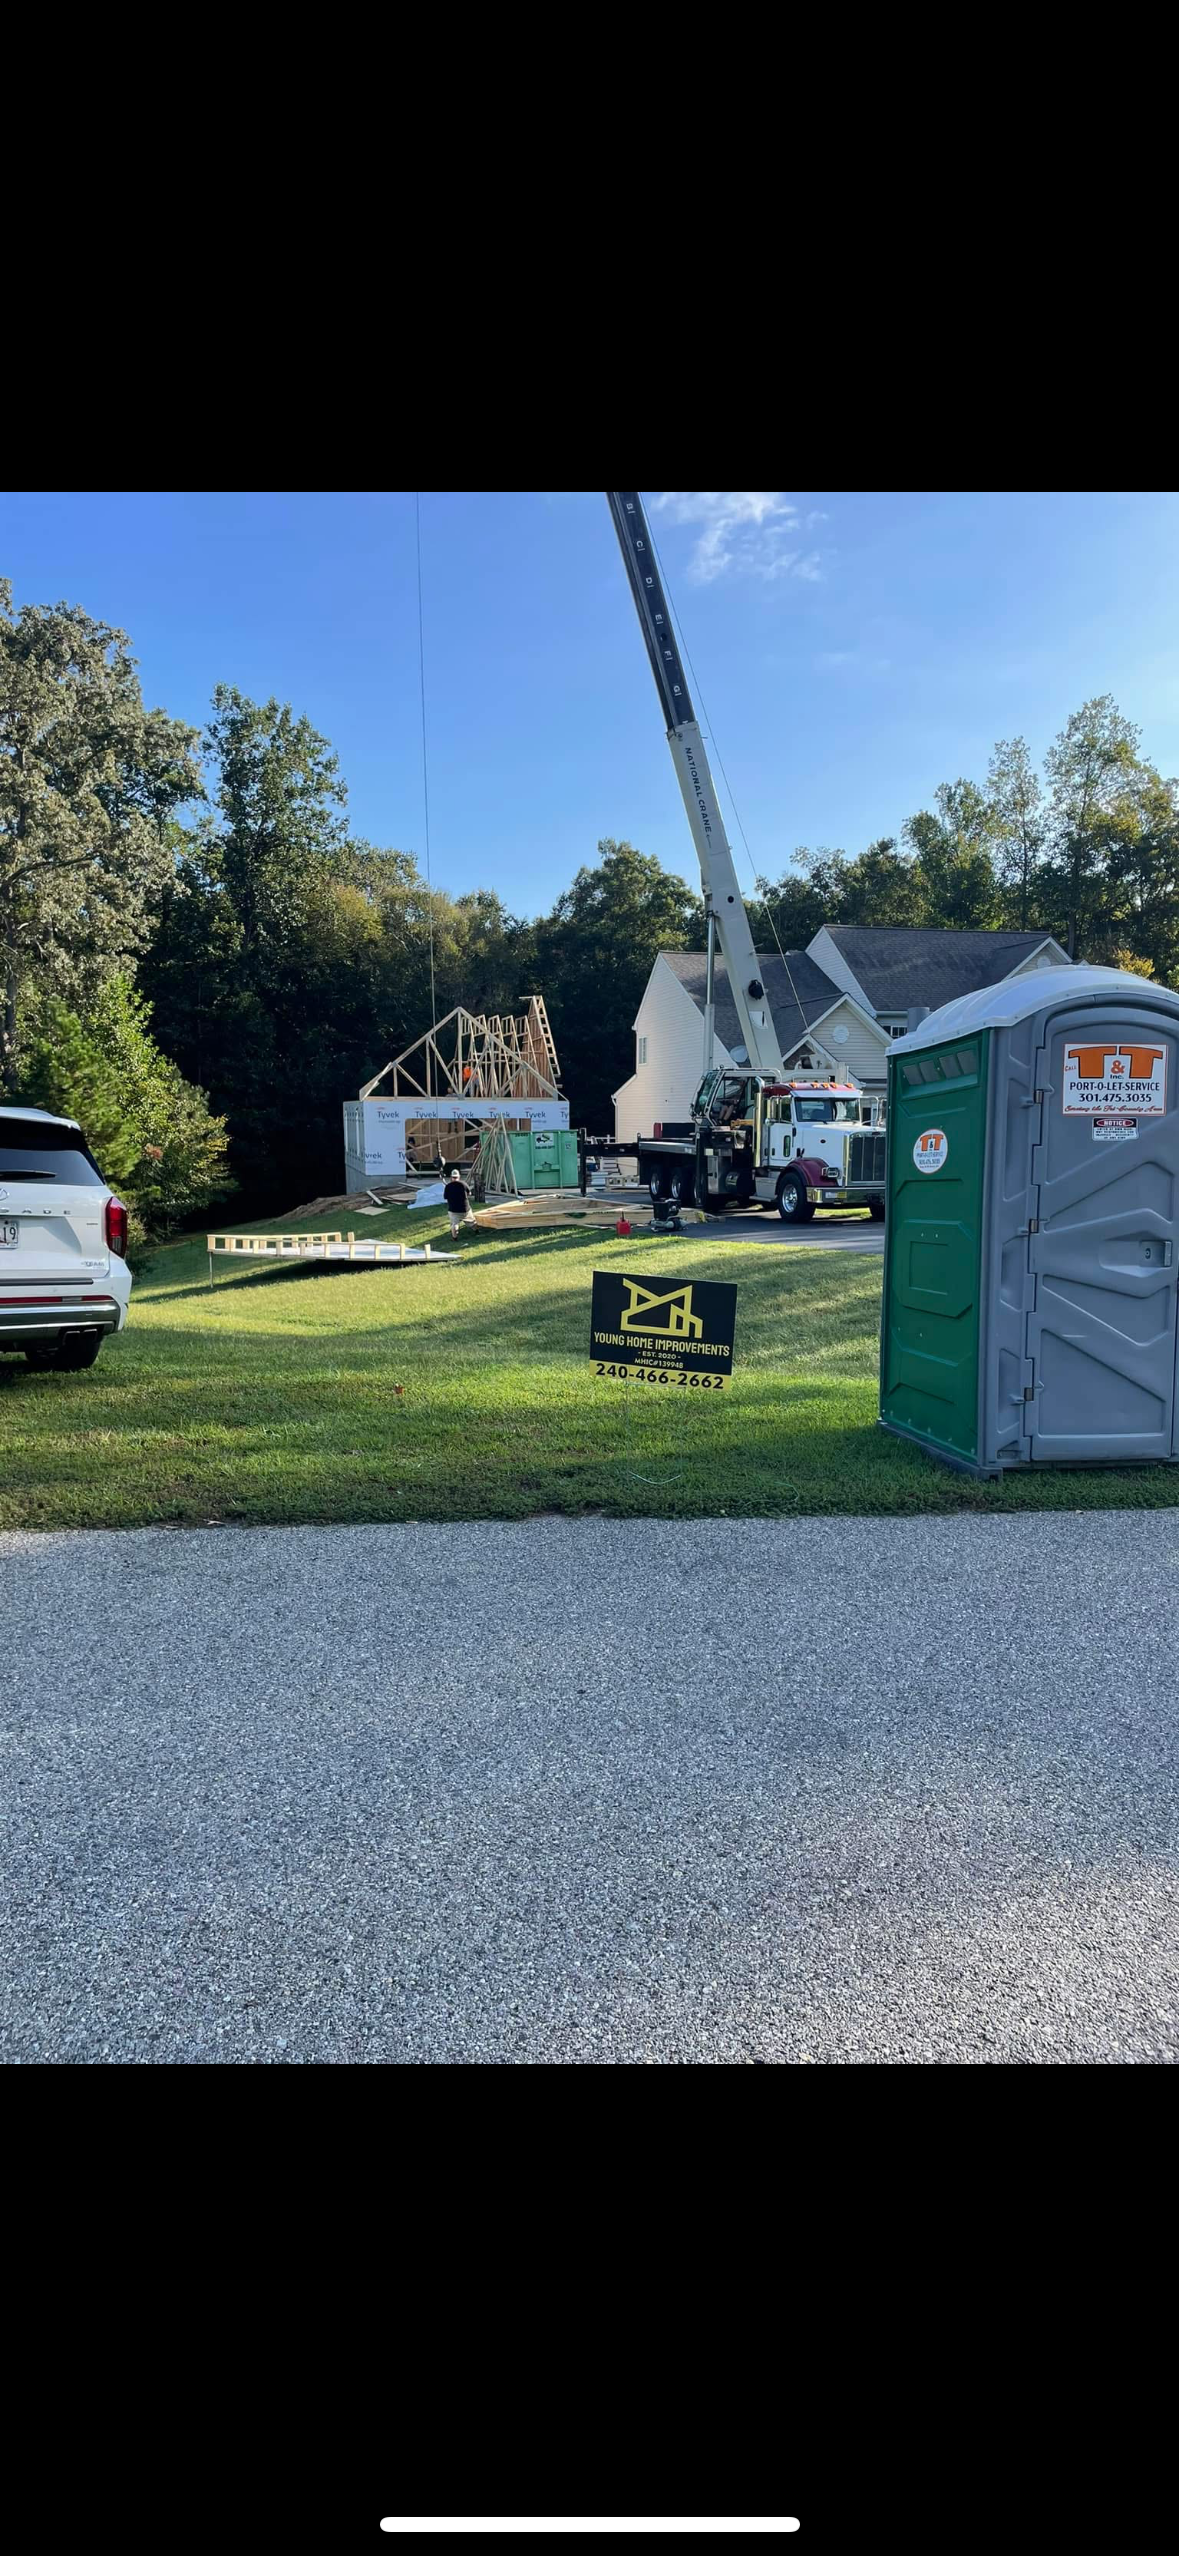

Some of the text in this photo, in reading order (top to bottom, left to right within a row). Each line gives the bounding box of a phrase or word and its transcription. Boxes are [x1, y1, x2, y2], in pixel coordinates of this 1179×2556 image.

[685, 747, 712, 833] NATIONAL CRANE
[1069, 1081, 1160, 1091] PORT-O-LET-SERVICE
[1078, 1093, 1152, 1102] 301.475.3035
[377, 1111, 400, 1119] Tyvek
[594, 1331, 730, 1357] YOUNG HOME IMPROVEMENTS
[658, 1352, 676, 1360] 2020
[596, 1363, 724, 1389] 240-466-2662
